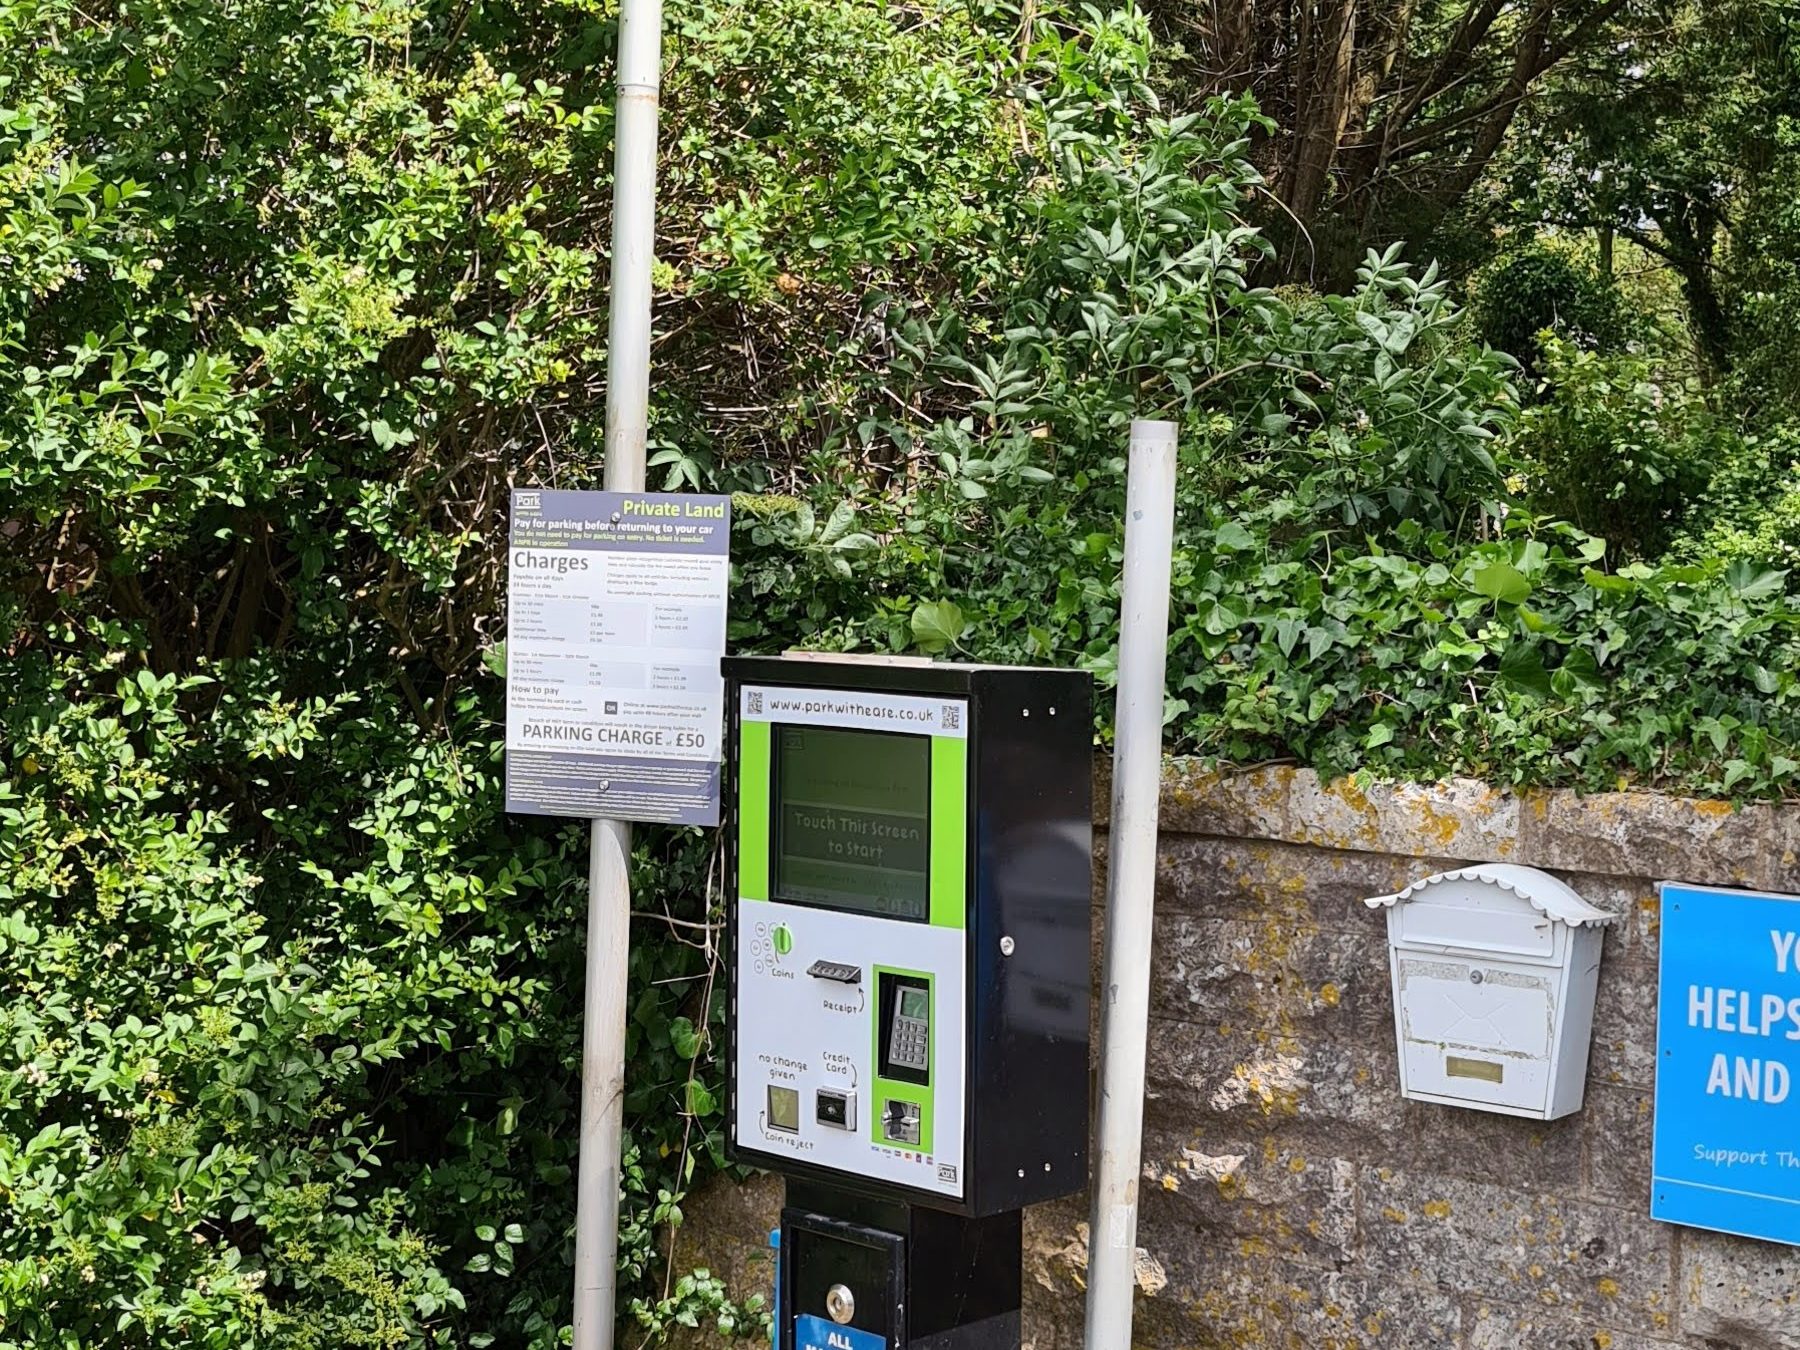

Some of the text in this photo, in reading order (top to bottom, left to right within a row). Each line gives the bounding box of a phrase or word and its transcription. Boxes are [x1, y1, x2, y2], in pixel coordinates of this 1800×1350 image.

[623, 500, 724, 519] Private Land
[514, 518, 714, 535] Pay for parking before returning to your car
[514, 551, 589, 574] Charges
[511, 685, 560, 696] How to pay
[770, 700, 933, 721] www.parkwithease.co.uk
[523, 724, 592, 742] PARKING
[598, 728, 663, 746] CHARGE
[676, 732, 705, 748] £50
[794, 811, 919, 840] Touch This Screen
[828, 840, 883, 859] to Start
[772, 967, 794, 979] Coins
[823, 999, 858, 1014] Receipt
[1688, 984, 1800, 1041] HELPS
[759, 1054, 808, 1072] no change
[823, 1051, 851, 1064] Credit
[769, 1068, 796, 1080] given
[826, 1063, 847, 1075] Card
[1706, 1053, 1790, 1105] AND
[765, 1131, 814, 1150] Coin reject
[1694, 1143, 1768, 1168] Support
[828, 1331, 853, 1350] ALL
